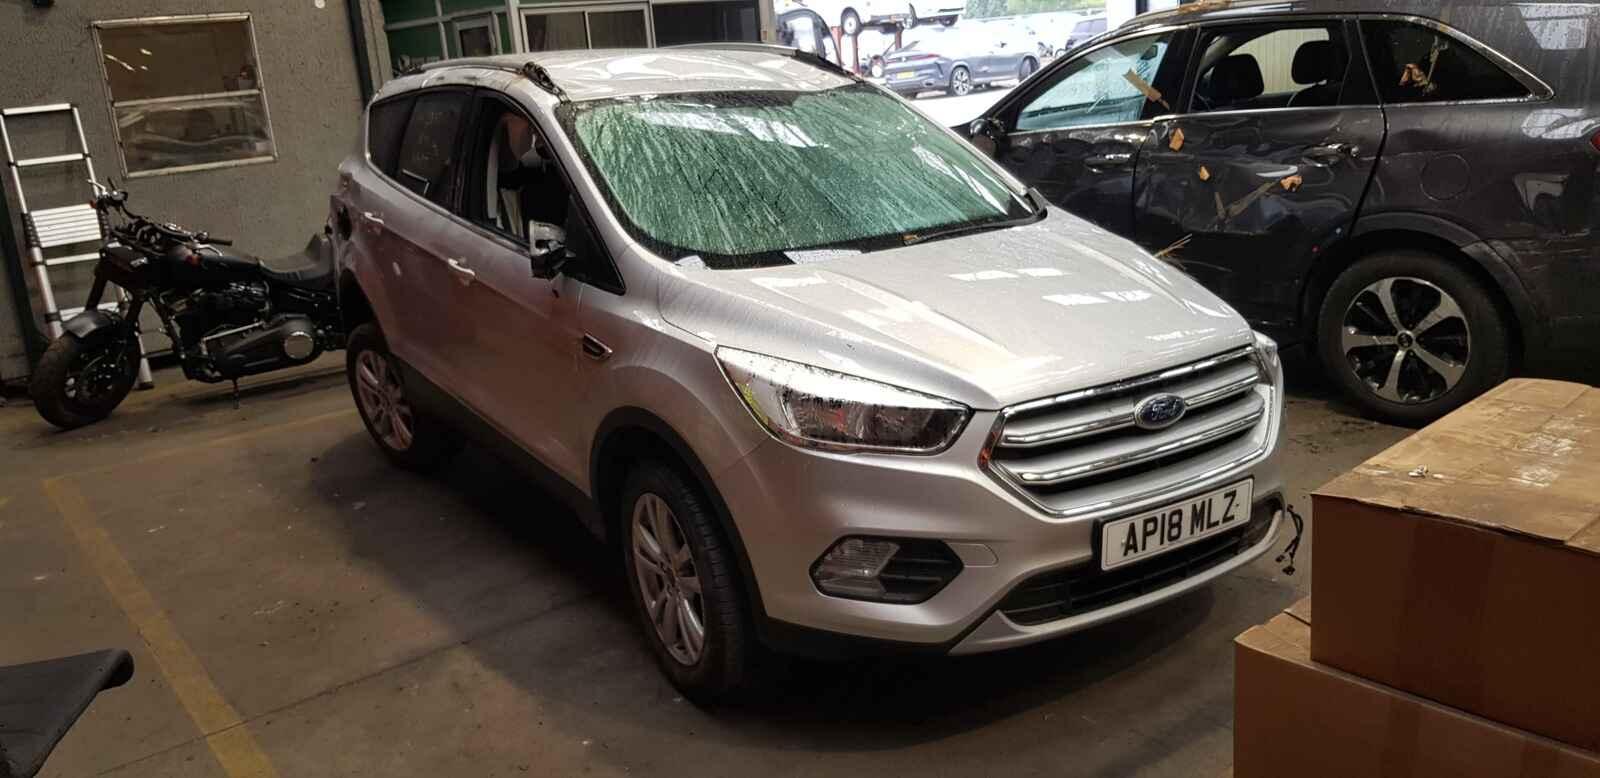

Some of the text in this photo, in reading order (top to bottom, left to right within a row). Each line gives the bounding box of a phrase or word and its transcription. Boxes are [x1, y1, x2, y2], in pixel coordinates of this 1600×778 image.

[1148, 398, 1181, 421] Ford
[1123, 490, 1236, 556] AP18 MLZ
